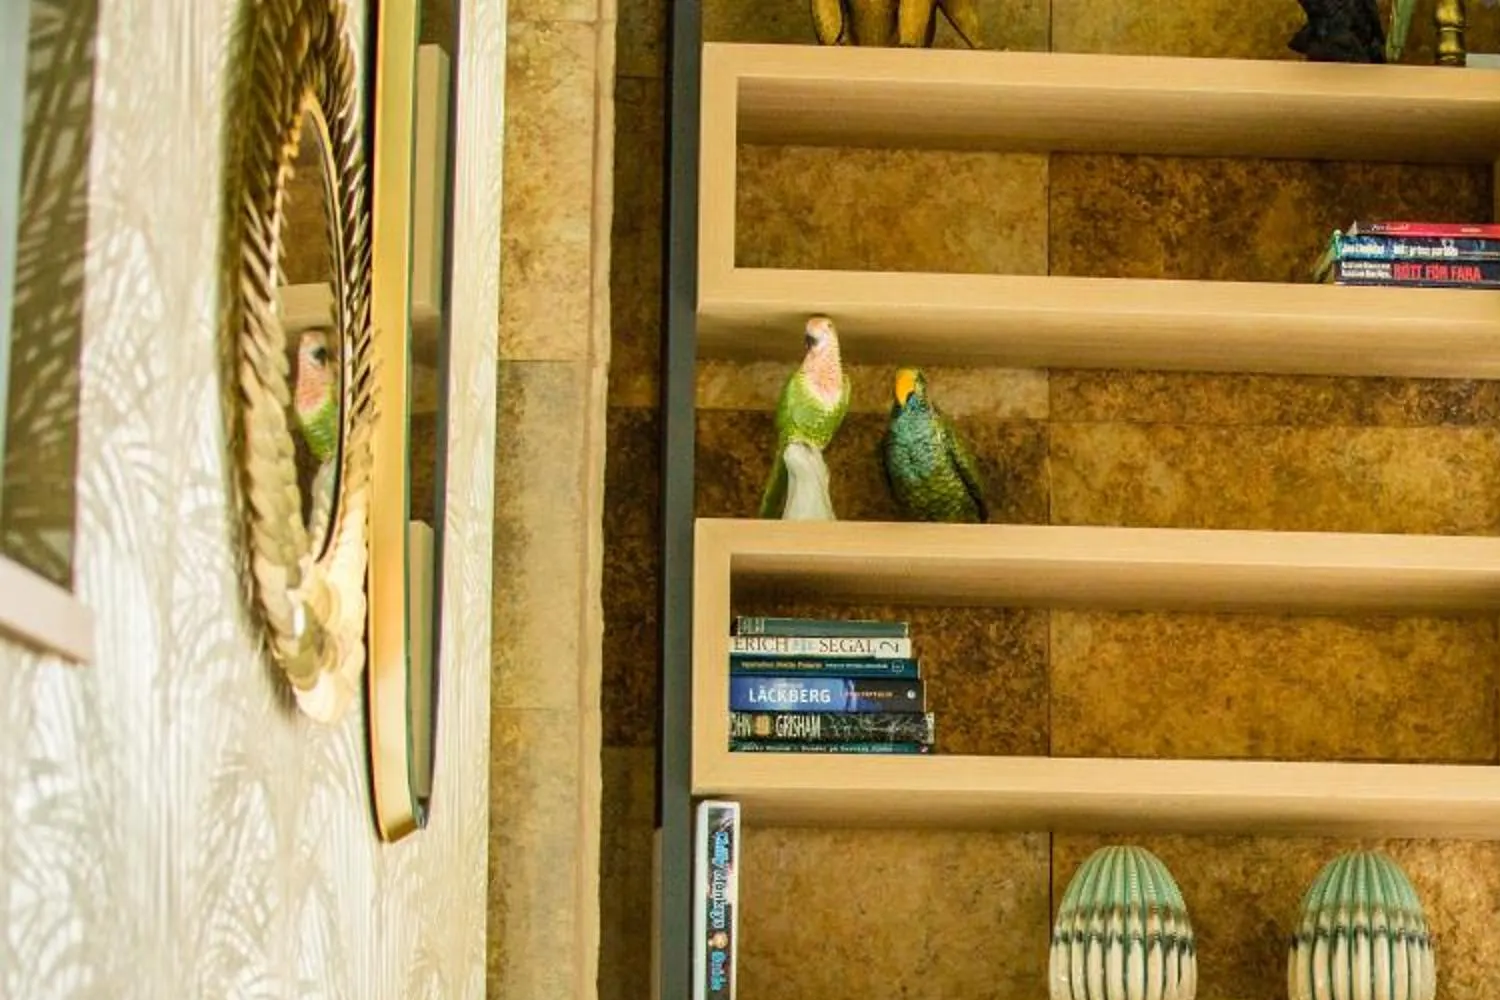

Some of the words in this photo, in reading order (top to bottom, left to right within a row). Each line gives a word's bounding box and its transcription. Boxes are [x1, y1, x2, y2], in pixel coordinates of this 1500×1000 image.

[735, 637, 789, 652] ERICH
[819, 639, 876, 653] SEGAL
[749, 685, 831, 703] LÄCKBERG
[730, 713, 751, 737] OHN
[775, 714, 821, 739] GRISHAM
